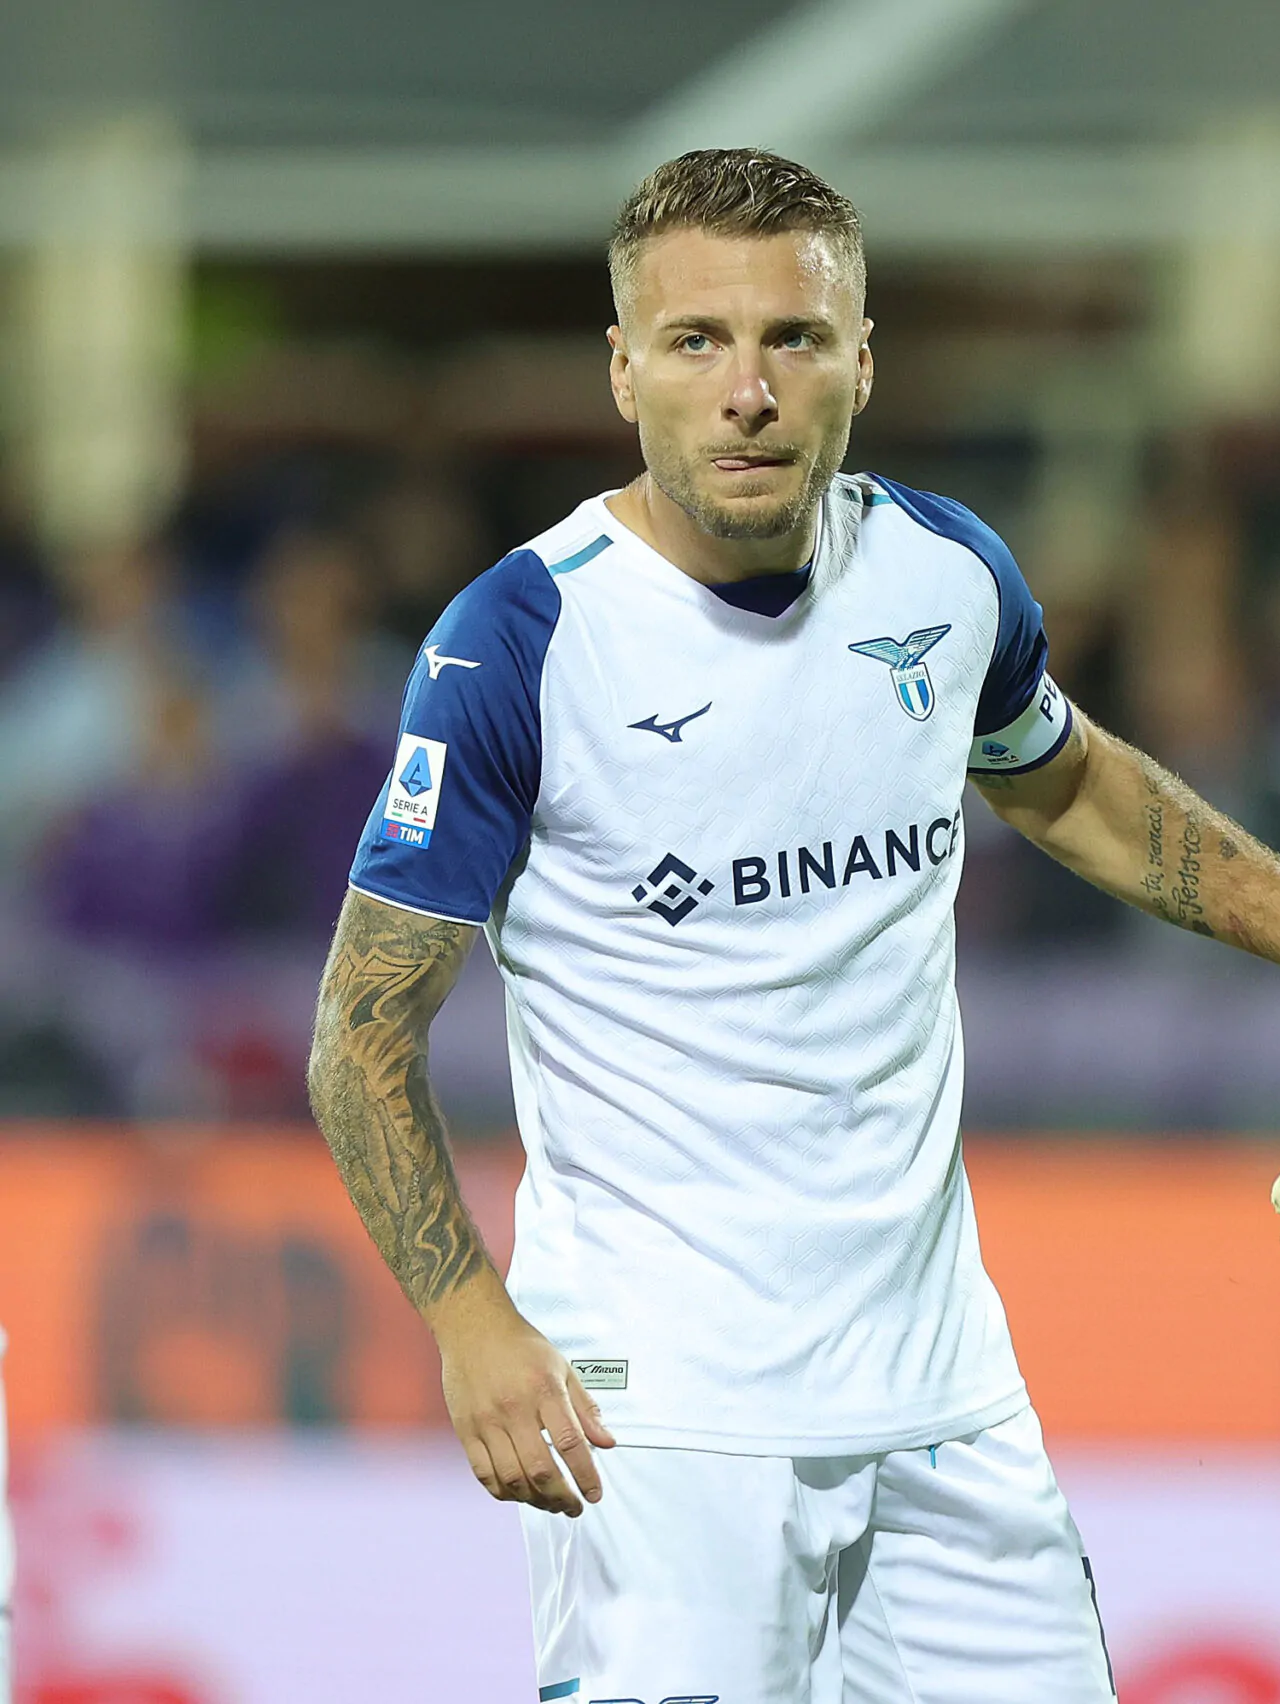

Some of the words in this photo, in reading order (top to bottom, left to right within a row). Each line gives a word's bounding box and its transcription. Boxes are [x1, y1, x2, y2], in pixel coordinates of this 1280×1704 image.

[393, 798, 419, 814] SERIE
[420, 805, 428, 816] A
[400, 826, 424, 845] TIM
[733, 808, 960, 906] BINANCE
